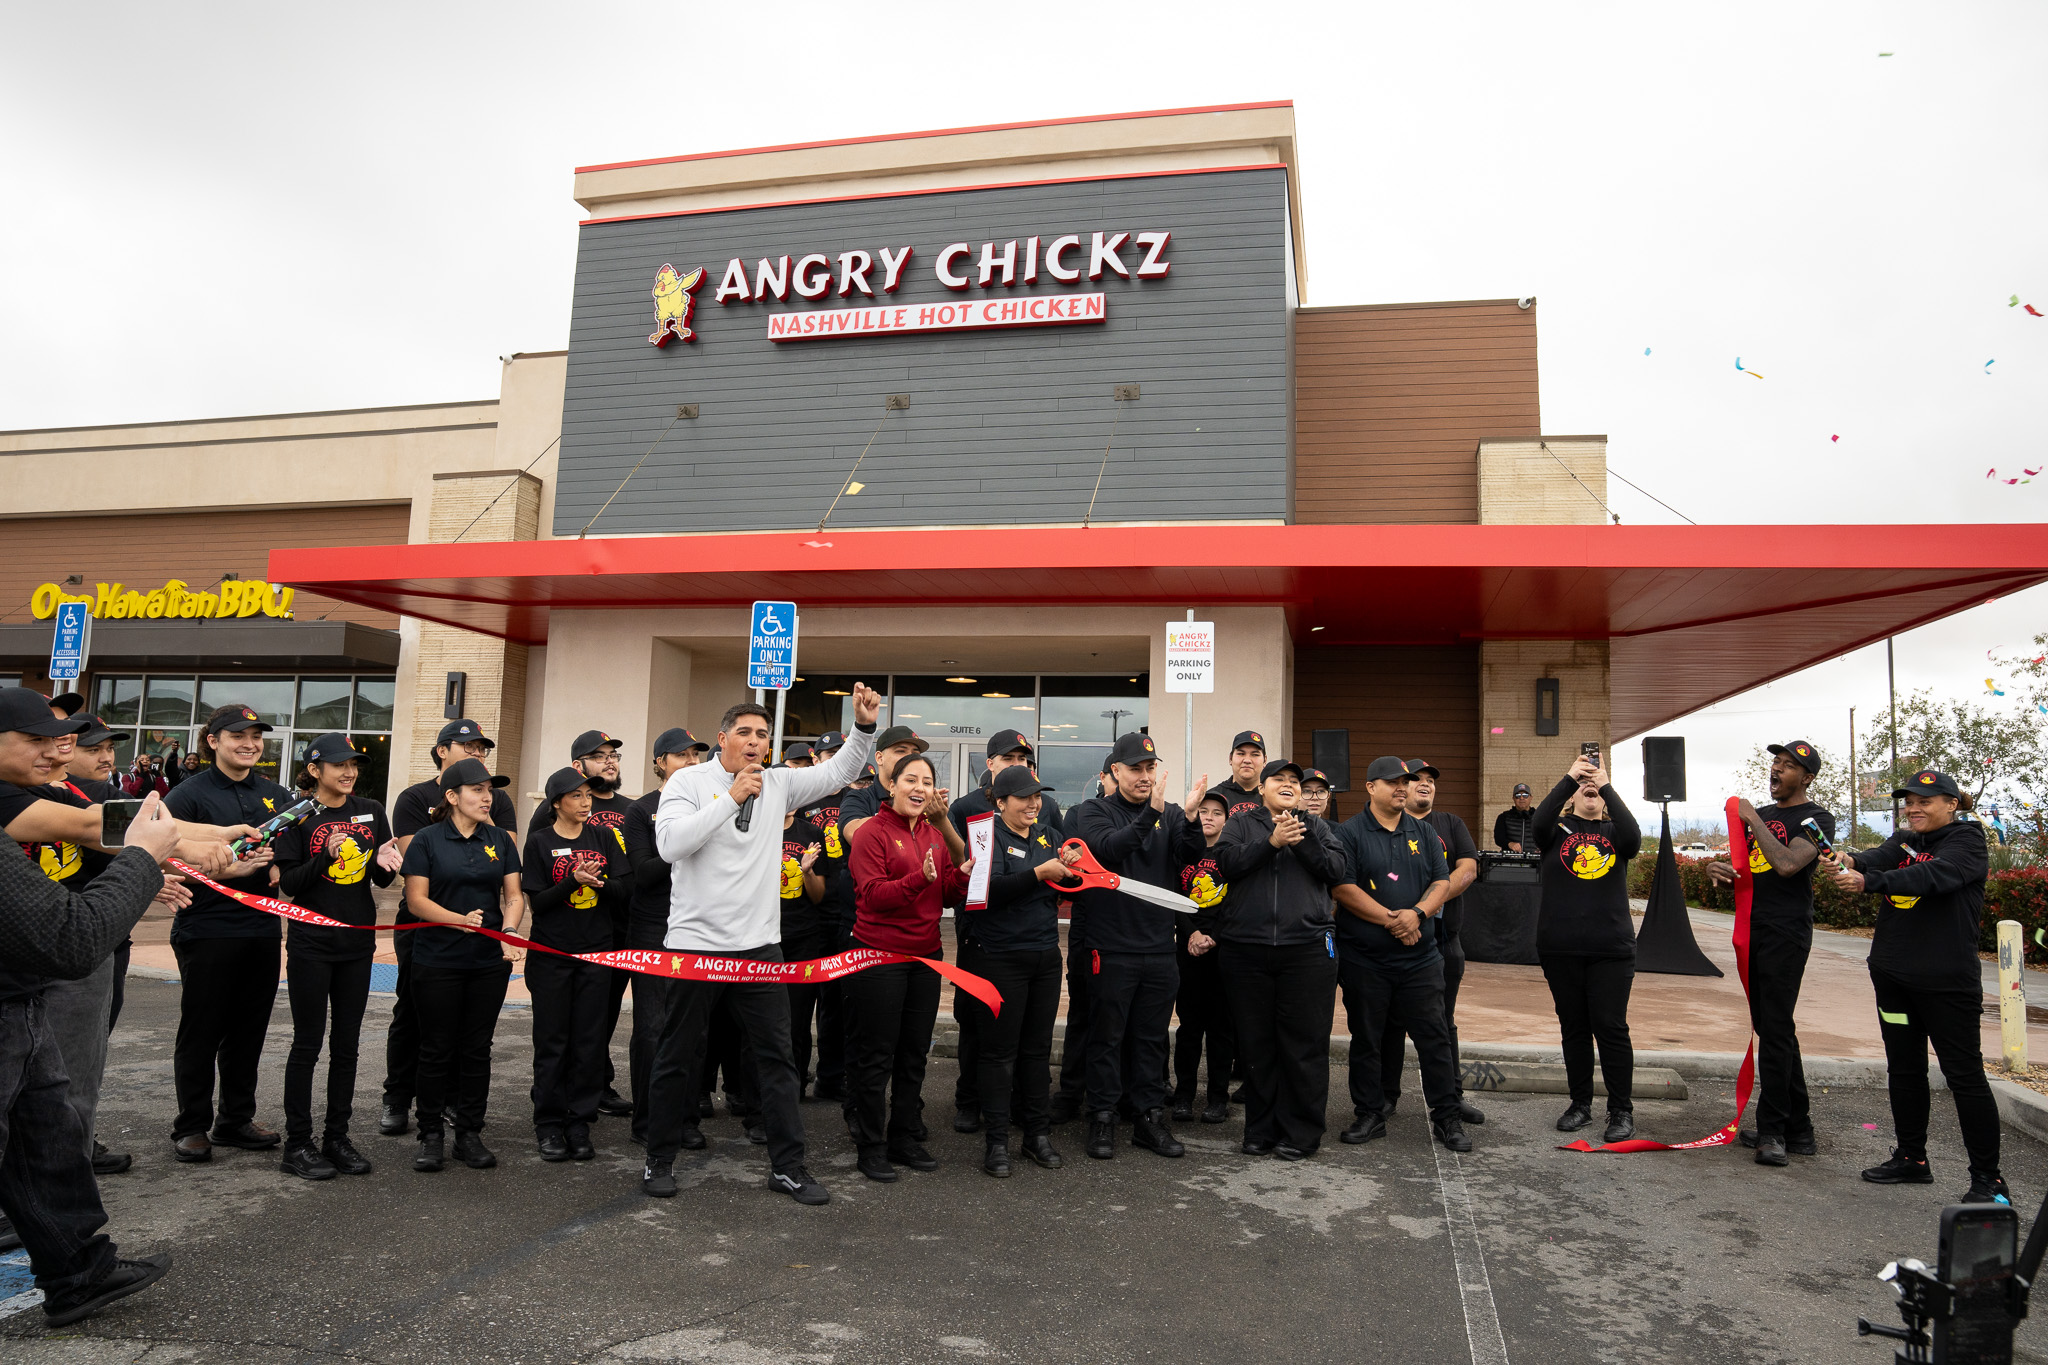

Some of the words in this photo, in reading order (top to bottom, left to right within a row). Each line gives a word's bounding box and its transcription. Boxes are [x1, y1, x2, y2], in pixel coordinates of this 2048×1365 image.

[715, 246, 914, 306] ANGRY
[935, 231, 1172, 291] CHICKZ
[771, 308, 908, 335] NASHVILLE
[918, 304, 973, 326] HOT
[983, 296, 1101, 322] CHICKEN
[92, 579, 219, 619] Hawaiian
[1178, 632, 1208, 640] ANGRY
[753, 635, 792, 649] PARKING
[1178, 640, 1211, 648] CHICKZ
[760, 649, 784, 663] ONLY
[56, 659, 76, 668] MINIMUM
[1168, 659, 1211, 667] PARKING
[52, 668, 63, 677] FINE
[64, 668, 78, 677] $250
[756, 666, 785, 676] MINIMUM
[1176, 672, 1202, 680] ONLY
[751, 676, 766, 685] FINE
[770, 676, 789, 686] $250
[950, 725, 975, 734] SUITE
[975, 727, 981, 735] 6
[602, 813, 625, 825] CHIC
[312, 826, 330, 854] NGRY
[1562, 835, 1580, 857] ANGRY
[255, 898, 311, 917] ANGRY
[605, 950, 662, 965] CHICKZ
[820, 955, 843, 972] ANGRY
[844, 949, 893, 964] CHICKZ
[616, 962, 646, 971] CHICKEN
[693, 957, 743, 973] ANGRY
[747, 962, 798, 975] CHICKZ
[857, 959, 882, 969] CHICKEN
[706, 973, 740, 981] NASHVILLE
